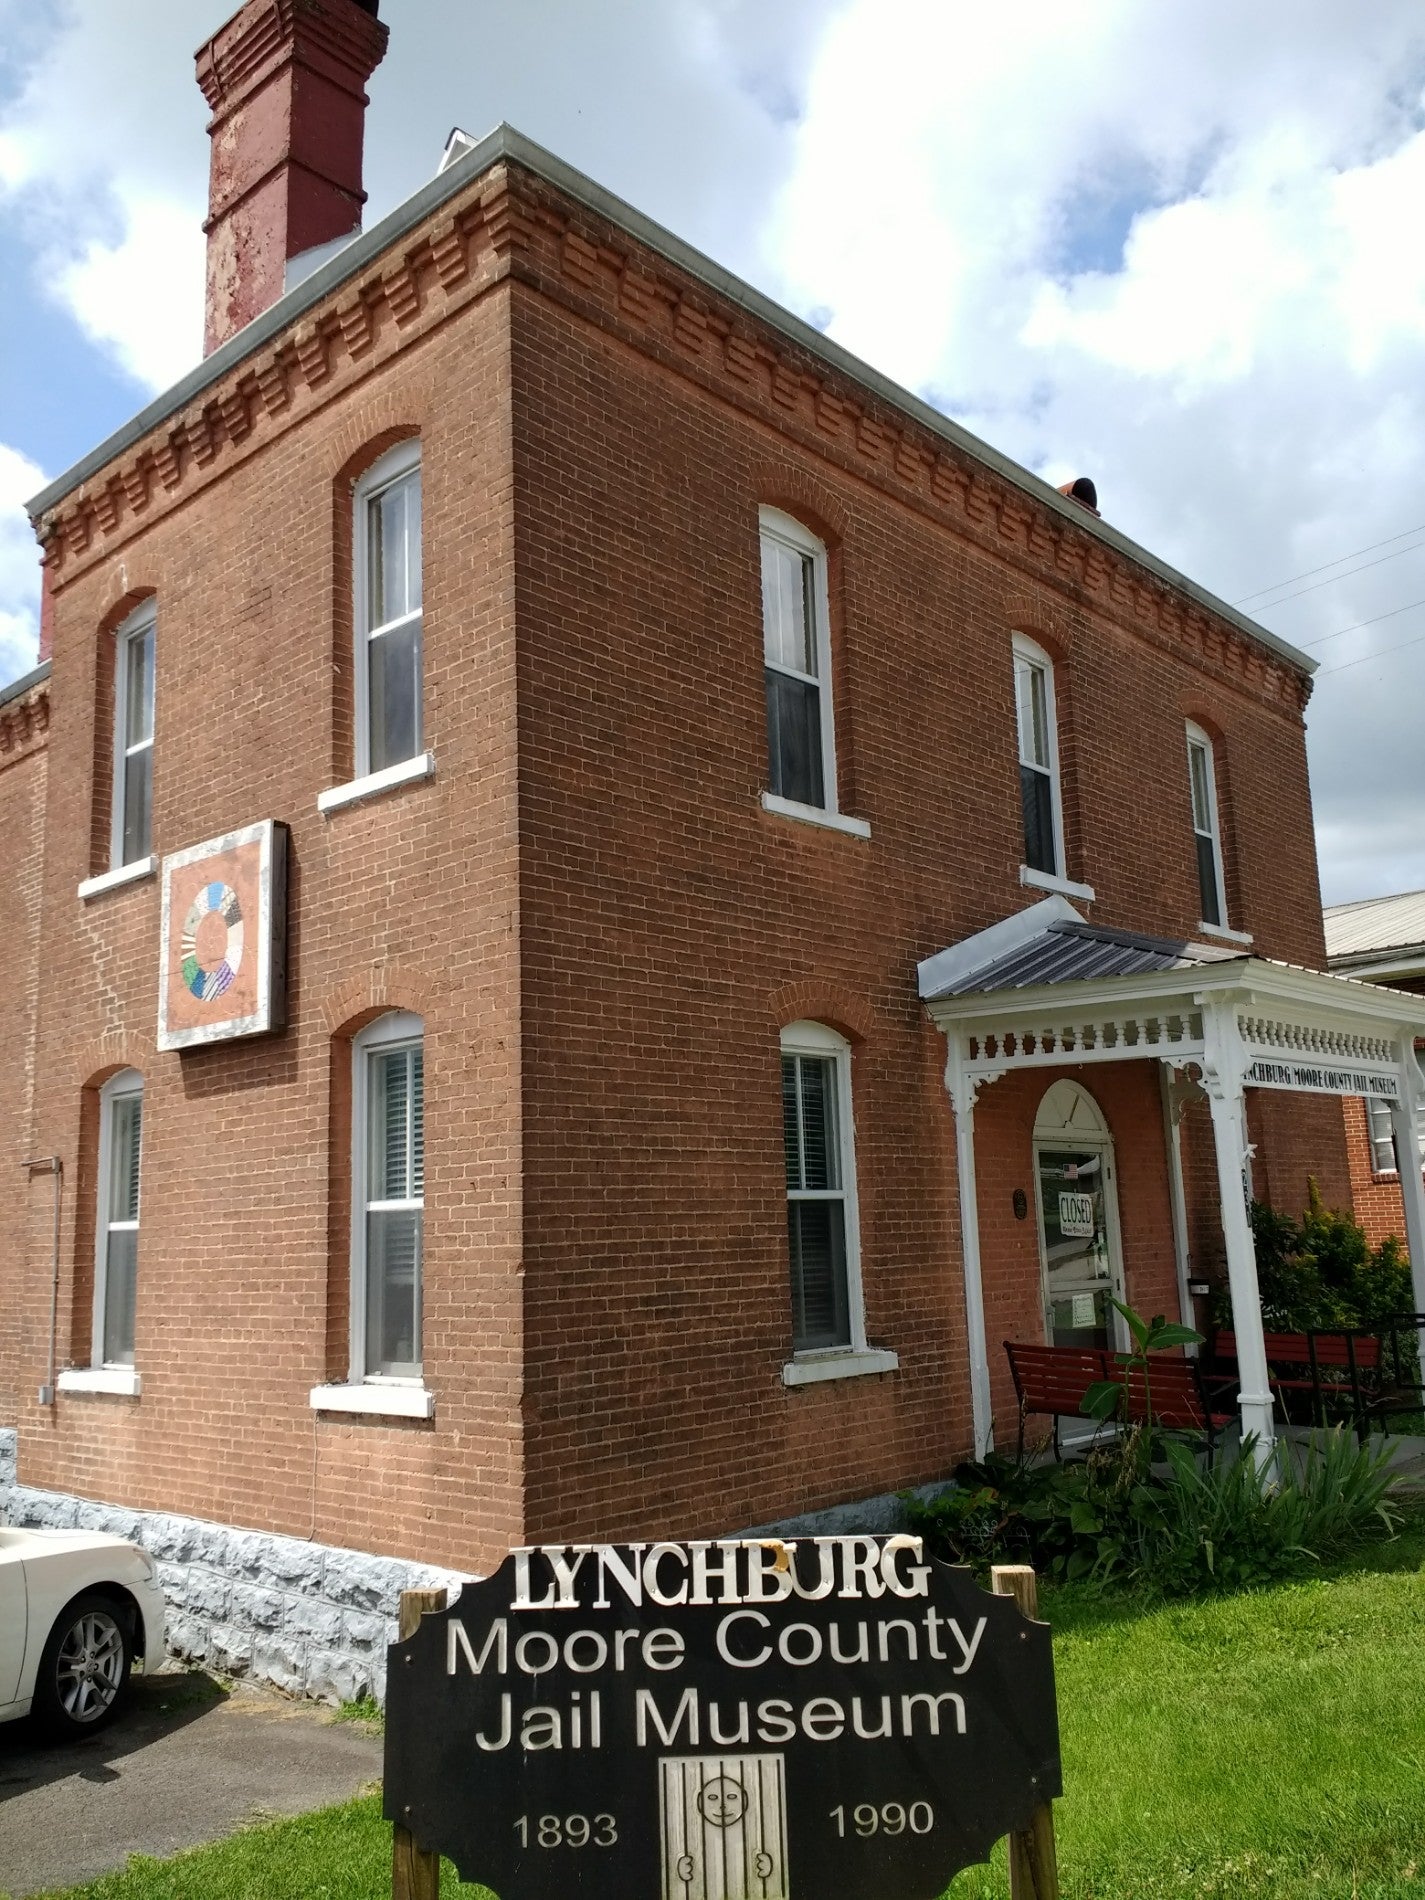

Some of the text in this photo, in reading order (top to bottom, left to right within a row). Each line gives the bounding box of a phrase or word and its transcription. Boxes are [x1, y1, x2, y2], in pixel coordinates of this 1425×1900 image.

[1243, 1062, 1397, 1094] NCHBURG MOORE COUNTY JAIL MUSEUM
[1061, 1197, 1091, 1223] CLOSED
[509, 1536, 932, 1609] LYNCHBURG
[446, 1605, 988, 1676] Moore County
[475, 1688, 967, 1752] Jail Museum
[512, 1813, 619, 1849] 1893
[828, 1801, 934, 1838] 1990
